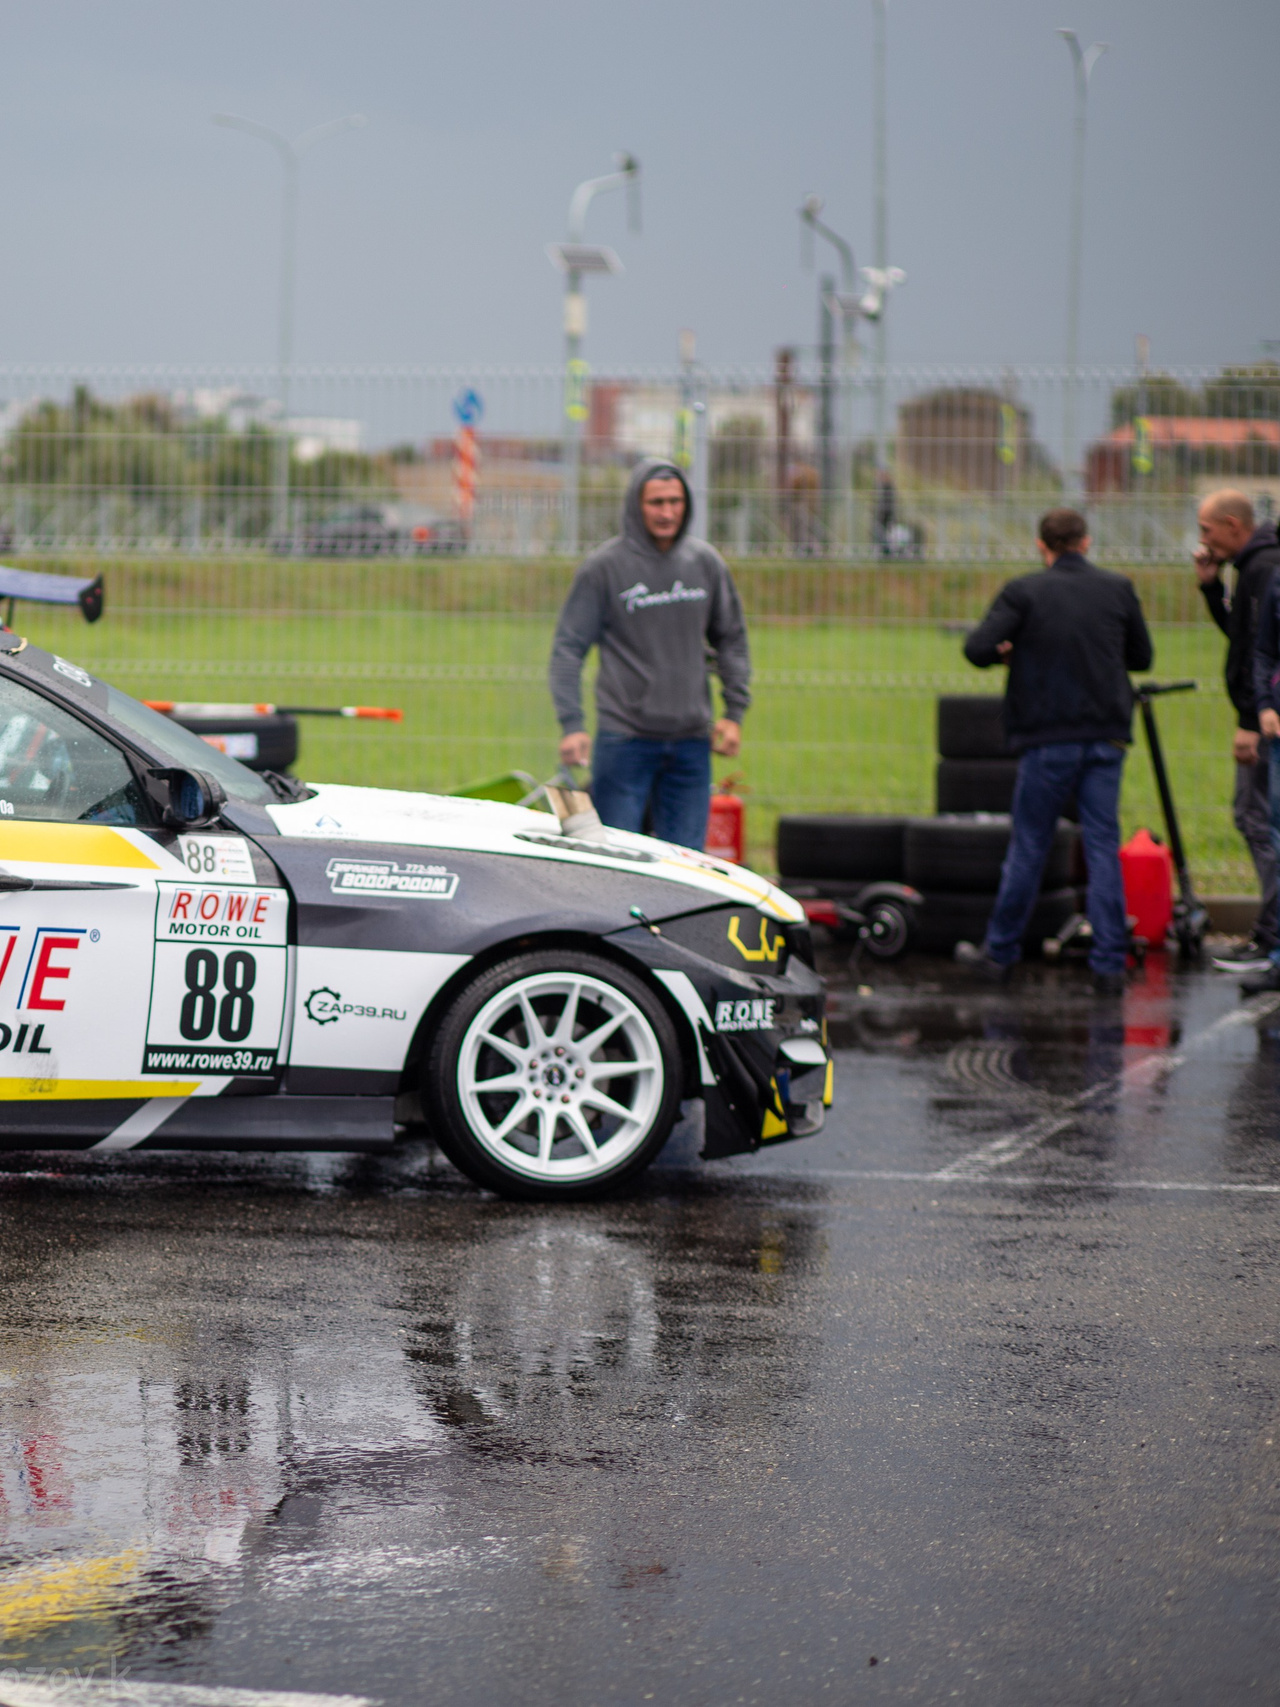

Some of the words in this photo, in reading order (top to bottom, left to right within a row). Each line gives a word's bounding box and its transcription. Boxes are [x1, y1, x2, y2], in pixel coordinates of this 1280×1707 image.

[186, 839, 216, 874] 88
[171, 891, 271, 923] ROWE
[169, 922, 231, 937] MOTOR
[236, 926, 262, 939] OIL
[179, 948, 257, 1043] 88
[317, 1000, 407, 1021] ZAP39.RU
[715, 999, 776, 1021] ROWE
[147, 1051, 274, 1072] www.rowe39.ru
